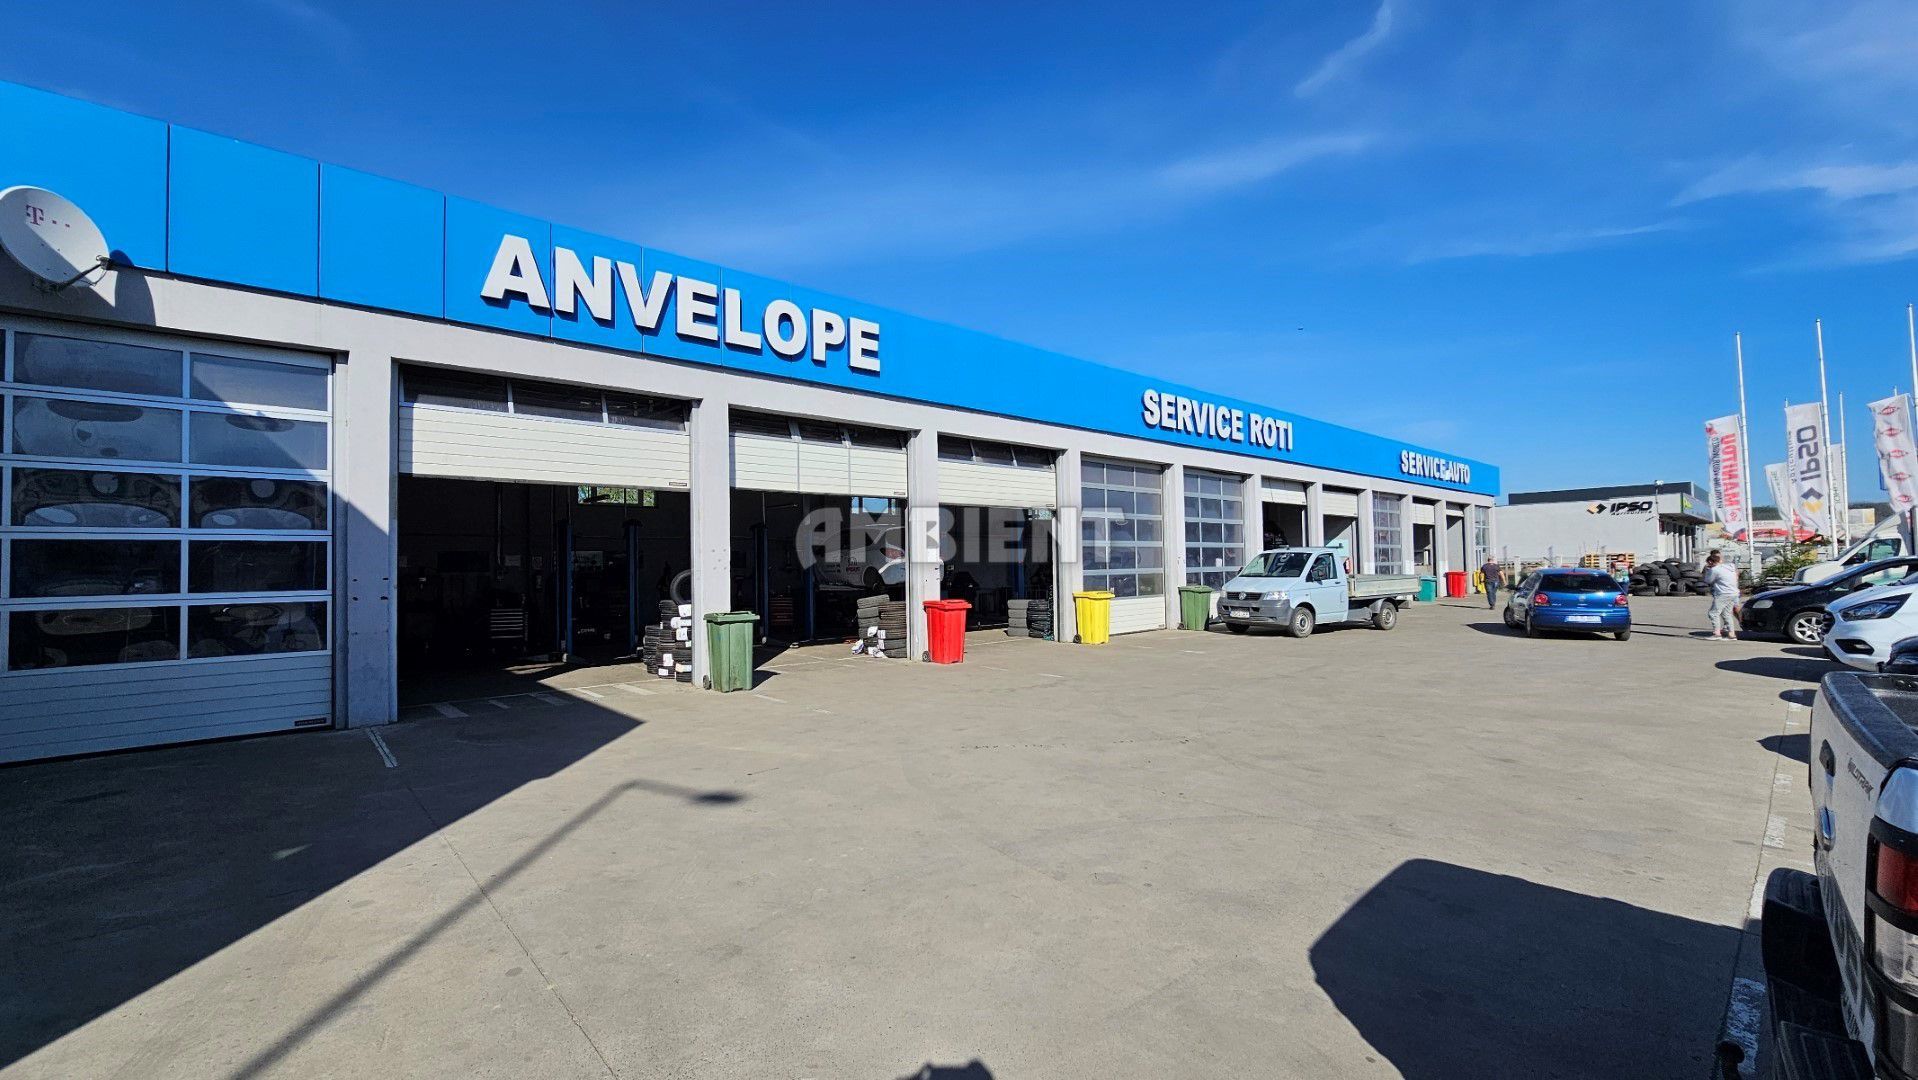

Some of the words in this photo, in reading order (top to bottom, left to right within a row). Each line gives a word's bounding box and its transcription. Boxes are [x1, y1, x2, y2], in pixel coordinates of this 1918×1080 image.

[480, 234, 880, 373] ANVELOPE
[1142, 389, 1244, 441] SERVICE
[1250, 413, 1293, 450] ROTI
[1401, 450, 1446, 480] SERVICE
[1446, 460, 1470, 484] AUTO
[1610, 501, 1653, 513] IPSO
